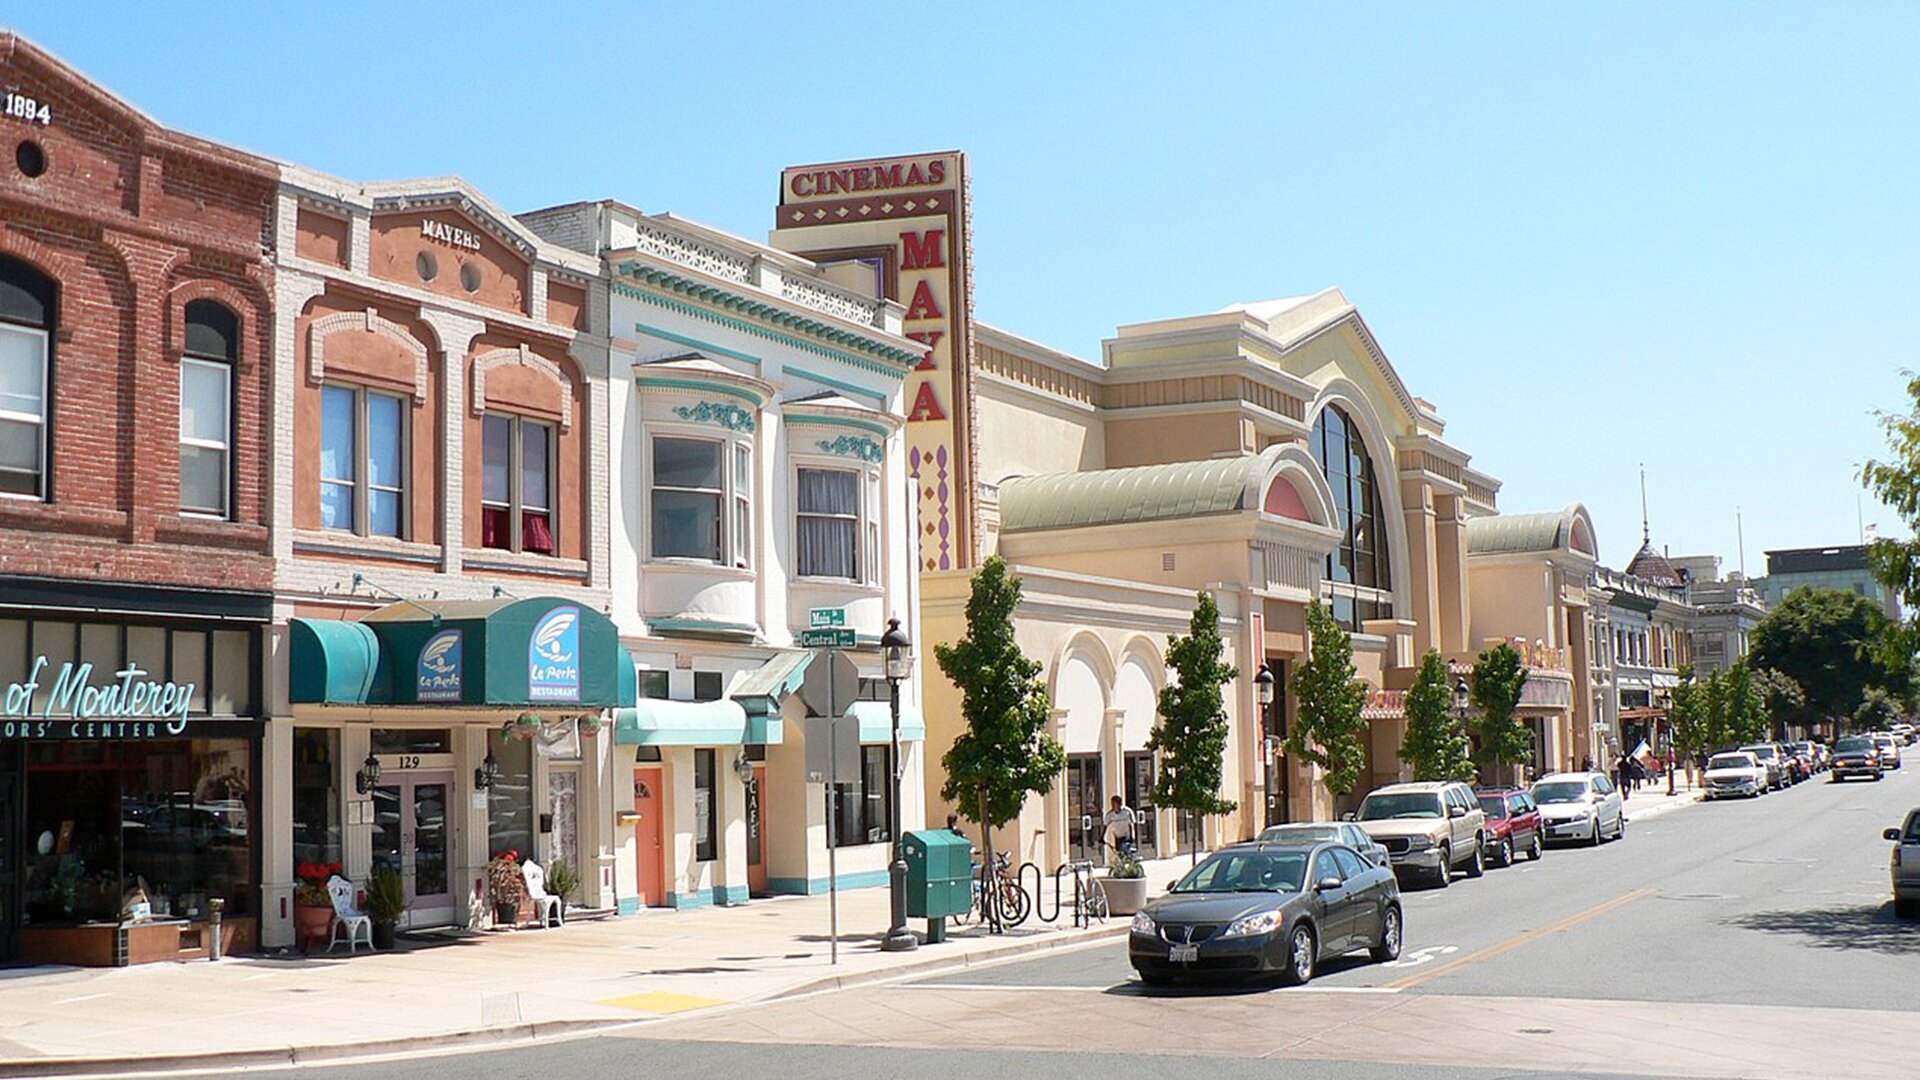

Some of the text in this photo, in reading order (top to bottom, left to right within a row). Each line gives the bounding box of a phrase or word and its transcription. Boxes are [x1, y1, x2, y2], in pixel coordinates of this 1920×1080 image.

[5, 93, 51, 125] 1894
[791, 160, 946, 197] CINEMAS
[422, 219, 481, 250] MAYERS
[899, 229, 945, 422] MAYA
[811, 611, 830, 625] Main
[803, 632, 838, 646] Central
[531, 664, 577, 680] La Perla
[420, 675, 431, 687] La
[6, 655, 195, 735] of Monterey
[530, 687, 577, 697] RESTAURANT
[71, 722, 155, 737] CENTER
[399, 755, 420, 769] 129
